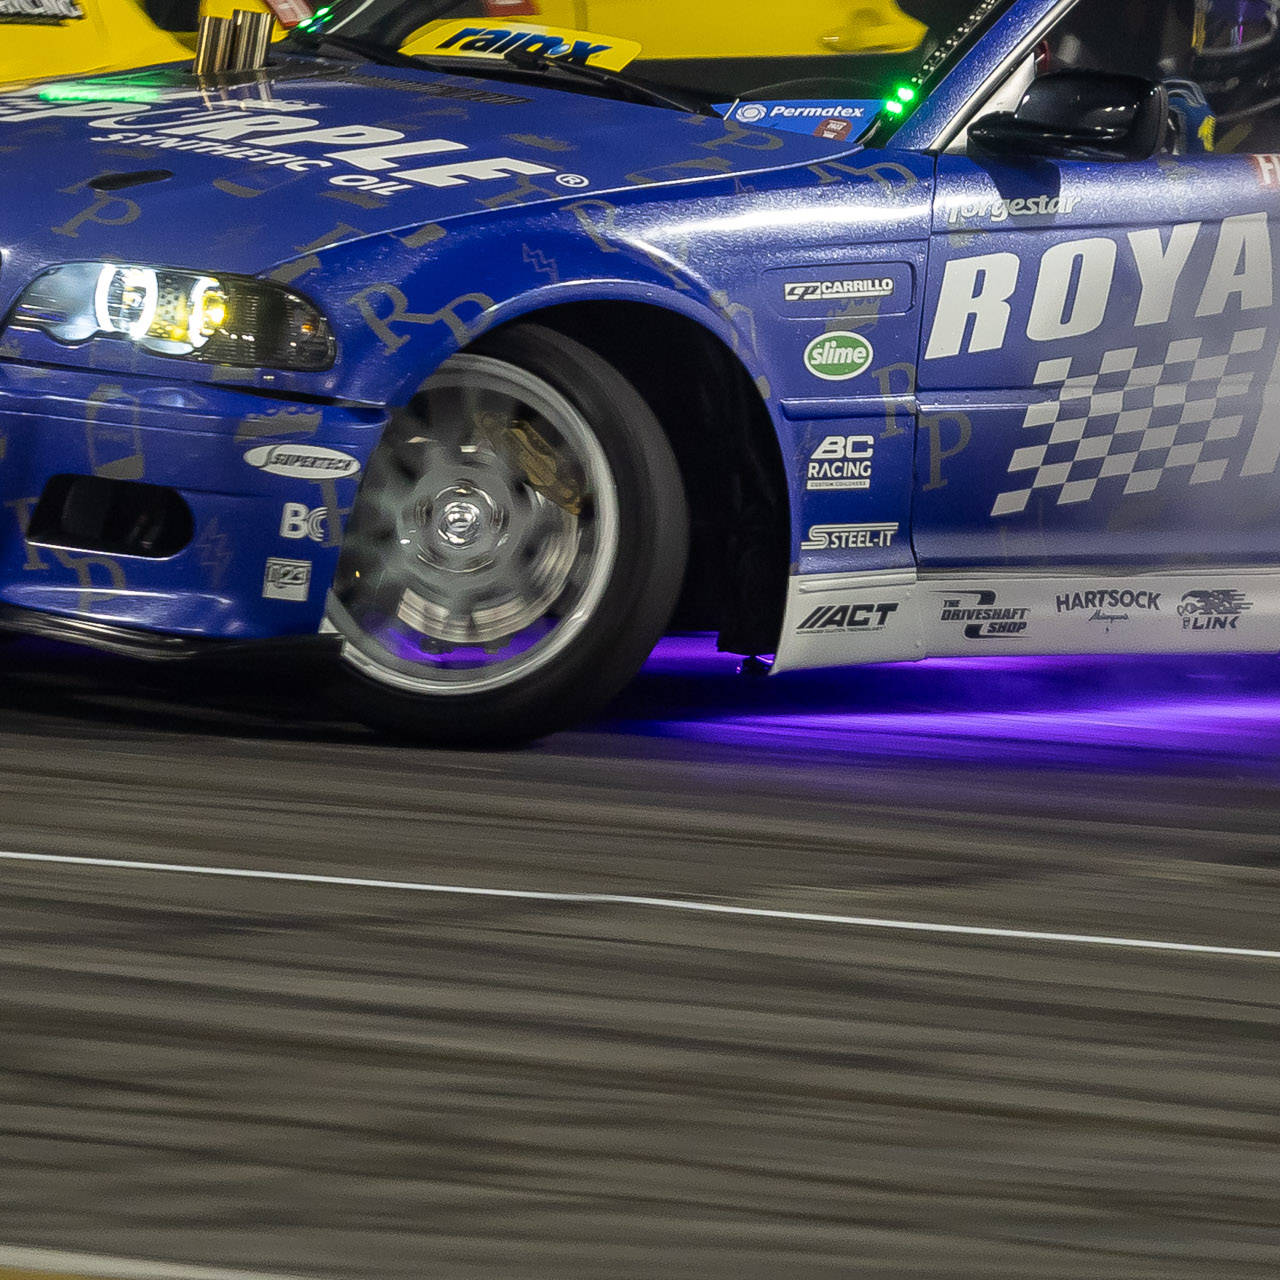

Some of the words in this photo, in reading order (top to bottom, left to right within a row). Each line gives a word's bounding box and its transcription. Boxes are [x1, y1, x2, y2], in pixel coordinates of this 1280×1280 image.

[770, 105, 864, 117] Permatex
[90, 132, 333, 171] SYNTHETIC
[330, 174, 413, 197] OIL
[821, 278, 894, 294] CARRILLO
[810, 340, 867, 365] slime
[810, 435, 874, 459] BC
[807, 461, 872, 478] RACING
[830, 531, 895, 549] STEEL-IT
[943, 599, 961, 609] THE
[1055, 589, 1162, 612] HARTSOCK
[940, 607, 1032, 621] DRIVESHAFT
[986, 621, 1028, 634] SHOP
